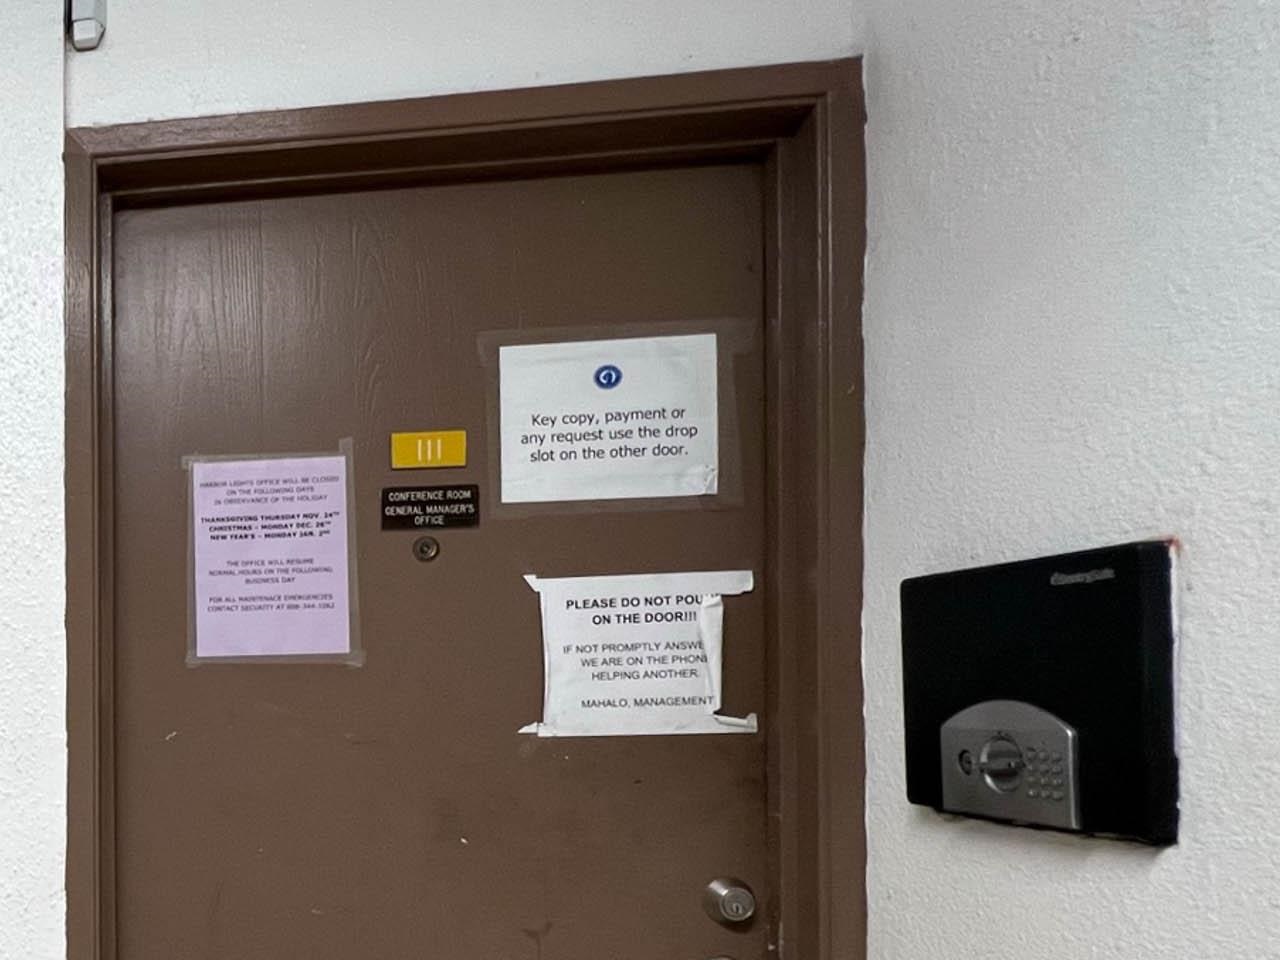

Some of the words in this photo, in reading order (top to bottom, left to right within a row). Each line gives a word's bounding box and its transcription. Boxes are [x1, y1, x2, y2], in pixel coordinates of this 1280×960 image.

[531, 414, 557, 428] Key
[562, 413, 599, 426] copy,
[605, 408, 666, 425] payment
[671, 408, 686, 419] or
[521, 432, 545, 446] any
[551, 429, 603, 445] request
[609, 428, 633, 440] use
[638, 426, 661, 438] the
[665, 424, 698, 440] drop
[530, 449, 555, 462] slot
[559, 449, 577, 461] on
[582, 446, 605, 460] the
[610, 444, 648, 459] other
[652, 443, 689, 456] door.
[254, 487, 294, 495] FOLLOWING
[388, 491, 444, 502] CONFERENCE
[447, 490, 471, 500] ROOM
[385, 506, 422, 516] GENERAL
[426, 504, 474, 515] MANAGER'S
[201, 515, 258, 523] THANKSGIVING
[261, 513, 300, 522] THURSDAY
[414, 515, 445, 526] OFFICE
[261, 523, 293, 531] MONDAY
[264, 531, 297, 539] MONDAY
[241, 559, 265, 567] OFFICE
[292, 566, 333, 574] FOLLOWING
[208, 604, 238, 612] CONTACT
[241, 603, 273, 611] SECURITY
[566, 597, 617, 609] PLEASE
[621, 596, 640, 608] DO
[644, 595, 672, 607] NOT
[592, 614, 611, 625] ON
[615, 612, 640, 624] THE
[644, 611, 697, 623] DOOR!!!
[563, 645, 573, 654] IF
[576, 643, 599, 653] NOT
[602, 642, 661, 653] PROMPTLY
[581, 657, 599, 667] WE
[601, 656, 623, 666] ARE
[626, 655, 643, 665] ON
[646, 655, 669, 665] THE
[591, 670, 640, 681] HELPING
[581, 698, 631, 708] MAHALO,
[634, 695, 714, 706] MANAGEMENT
